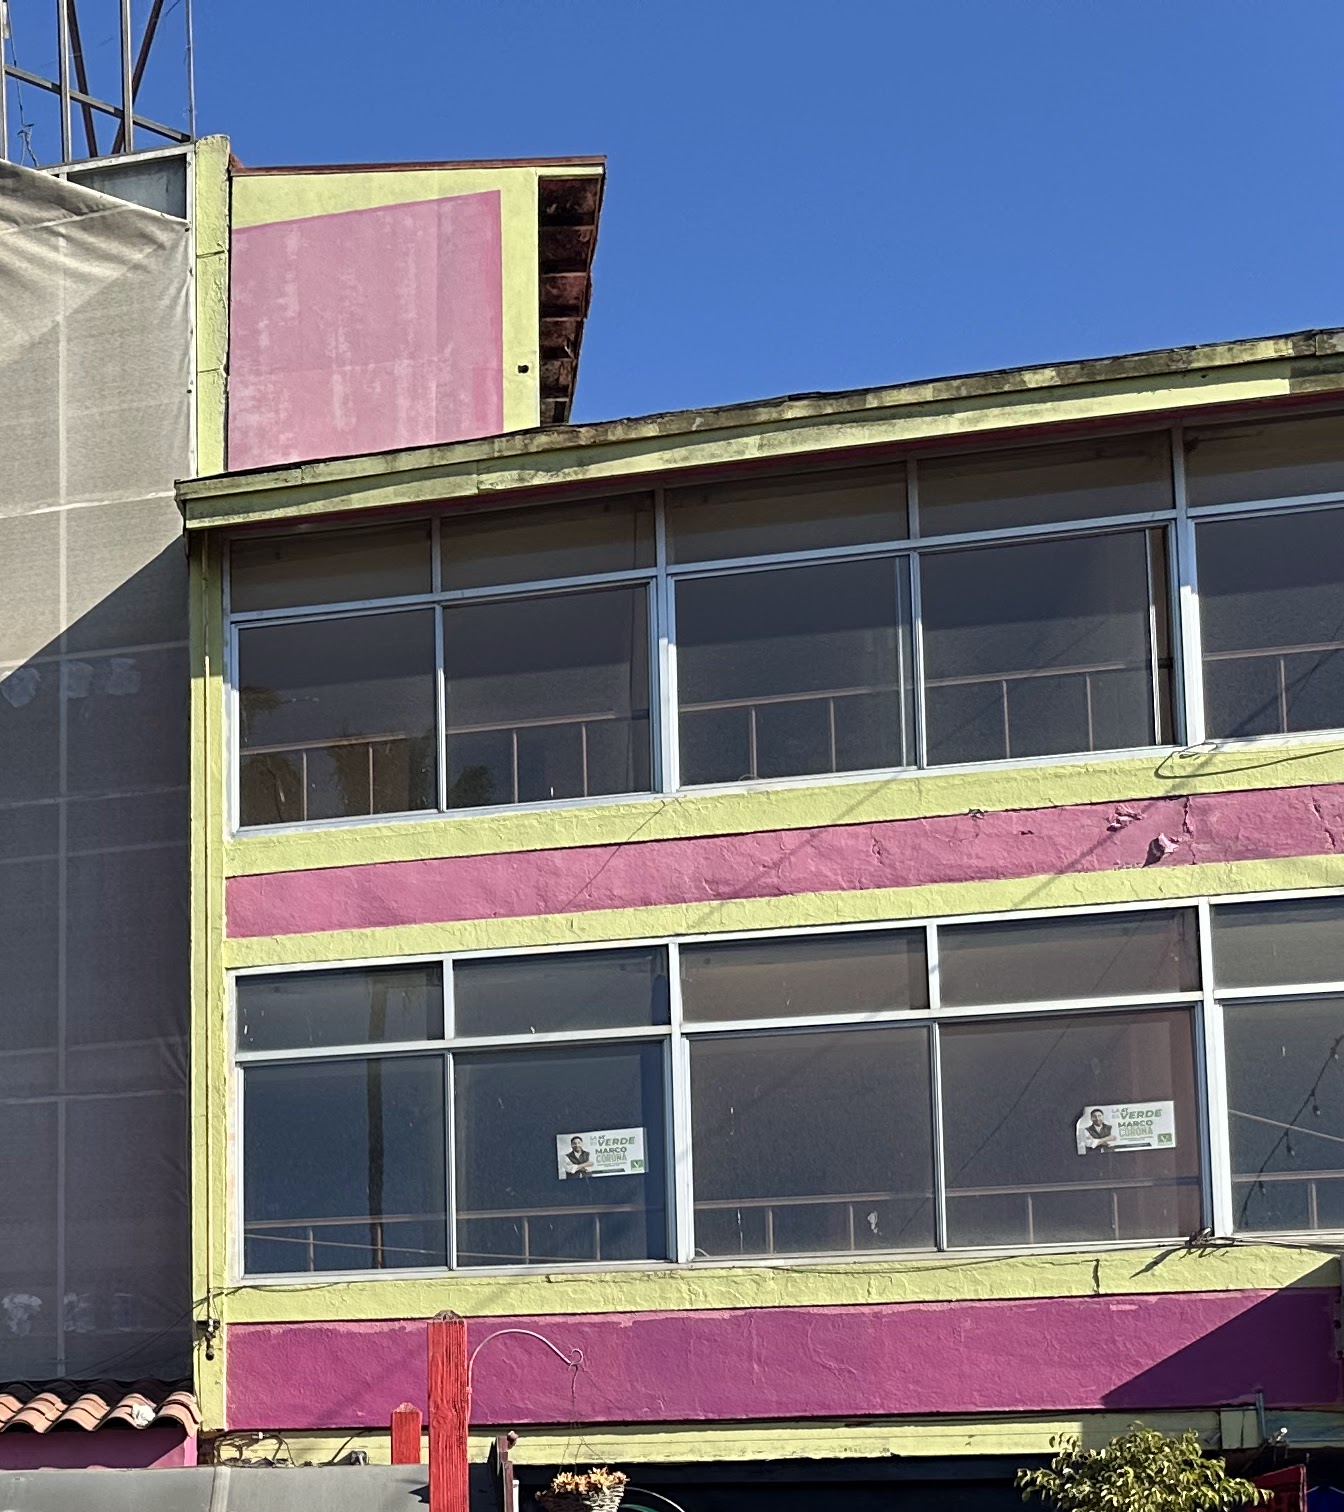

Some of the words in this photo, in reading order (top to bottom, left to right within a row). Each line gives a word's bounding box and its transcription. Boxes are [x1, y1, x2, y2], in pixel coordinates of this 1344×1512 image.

[1120, 1108, 1163, 1120] VERDE
[1117, 1119, 1154, 1129] MARCO
[597, 1135, 636, 1147] VERDE
[595, 1146, 628, 1155] MARCO
